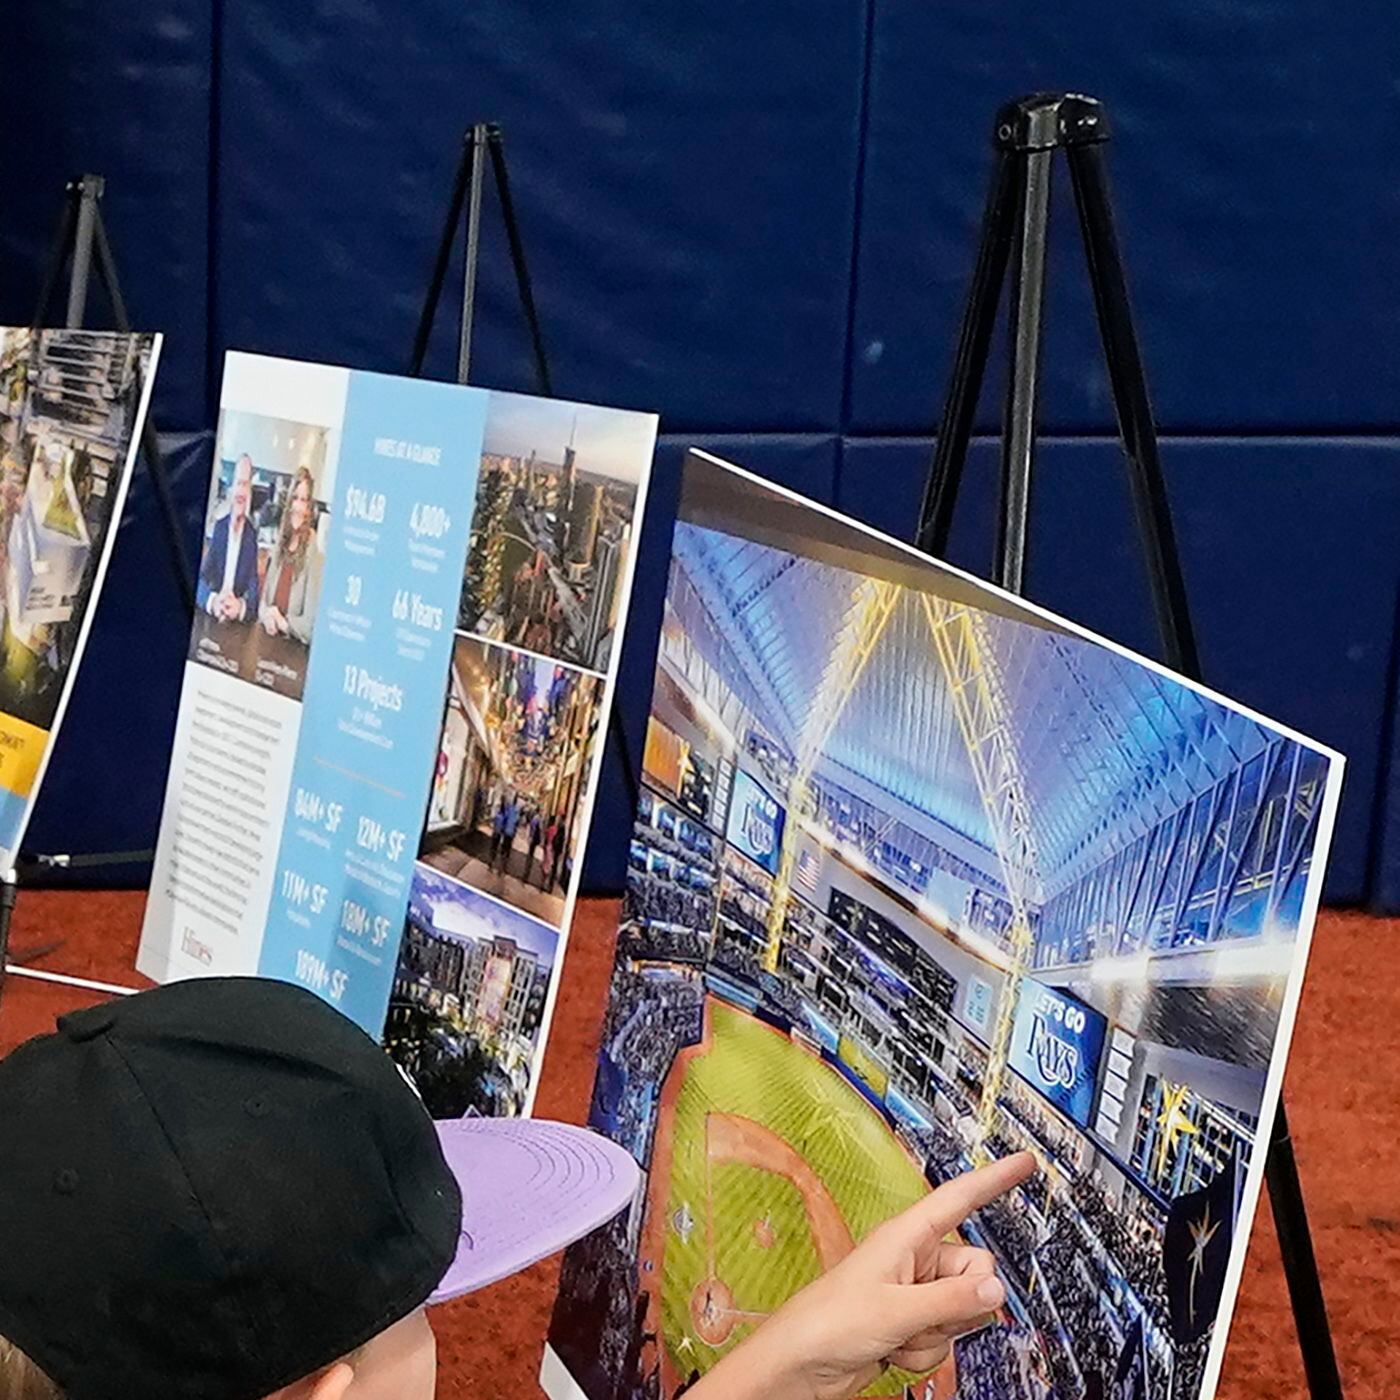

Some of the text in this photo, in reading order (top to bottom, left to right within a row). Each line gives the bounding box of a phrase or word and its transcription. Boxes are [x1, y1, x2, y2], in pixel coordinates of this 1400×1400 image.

[410, 591, 443, 632] Years
[343, 664, 358, 695] 13
[356, 668, 404, 712] Projects
[325, 801, 344, 833] SF
[386, 829, 406, 863] SF
[309, 883, 329, 915] SF
[371, 915, 391, 948] SF
[330, 969, 349, 1001] SF
[1064, 1005, 1086, 1034] GO
